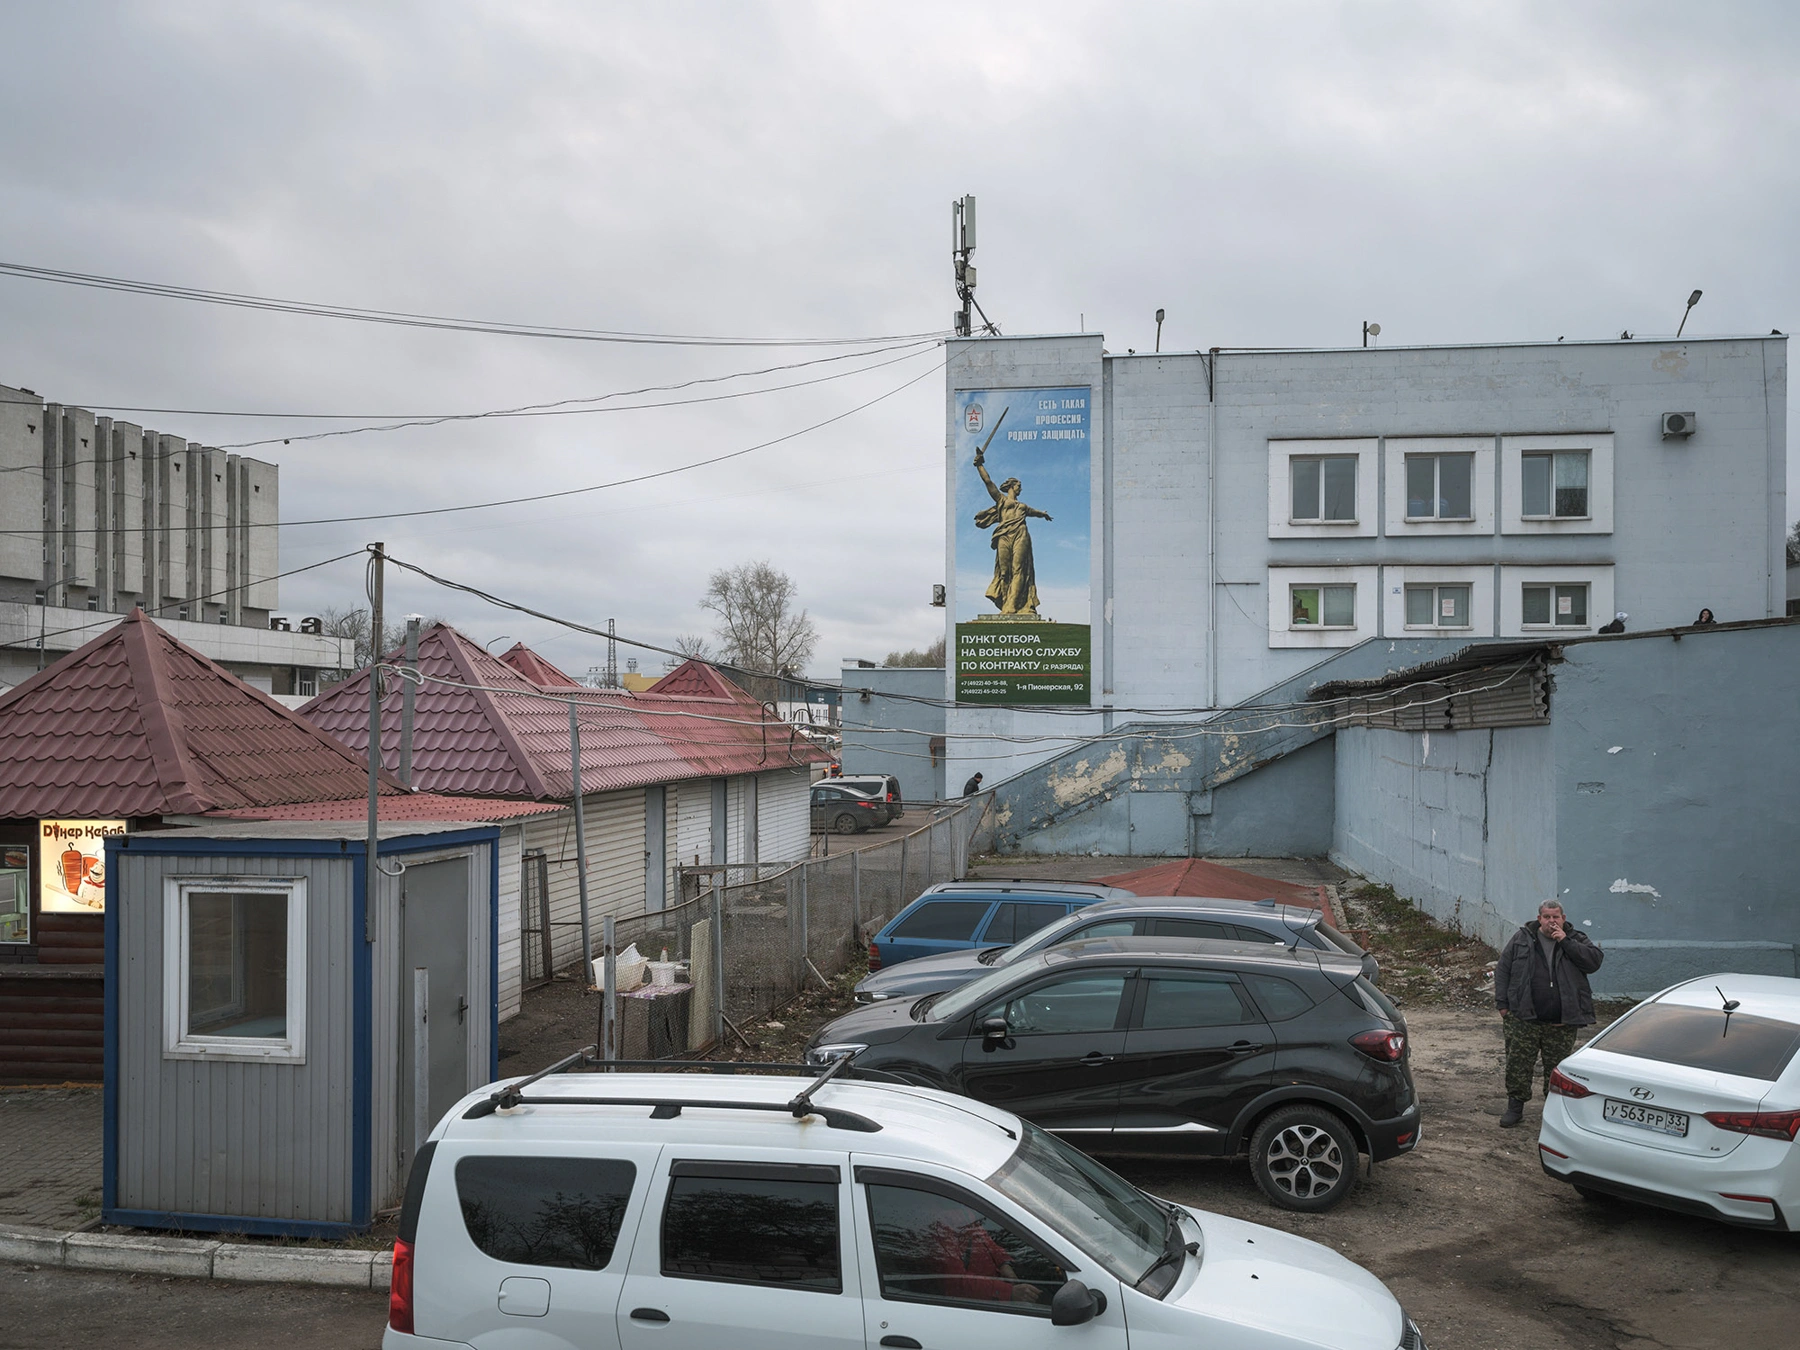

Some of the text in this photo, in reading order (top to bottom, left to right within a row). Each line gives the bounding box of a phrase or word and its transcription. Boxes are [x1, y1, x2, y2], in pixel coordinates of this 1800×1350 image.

[1038, 399, 1085, 410] ЕСТЬ ТАКАЯ
[1008, 429, 1085, 441] РОДИНУ ЗАЩИЩАТЬ
[961, 635, 1041, 644] ПУНКТ ОТБОРА
[961, 648, 1082, 657] НА ВОЕННУЮ СЛУЖБУ
[961, 662, 977, 670] ПО
[980, 661, 1041, 670] КОНТРАКТУ
[85, 826, 124, 839] Кебаб
